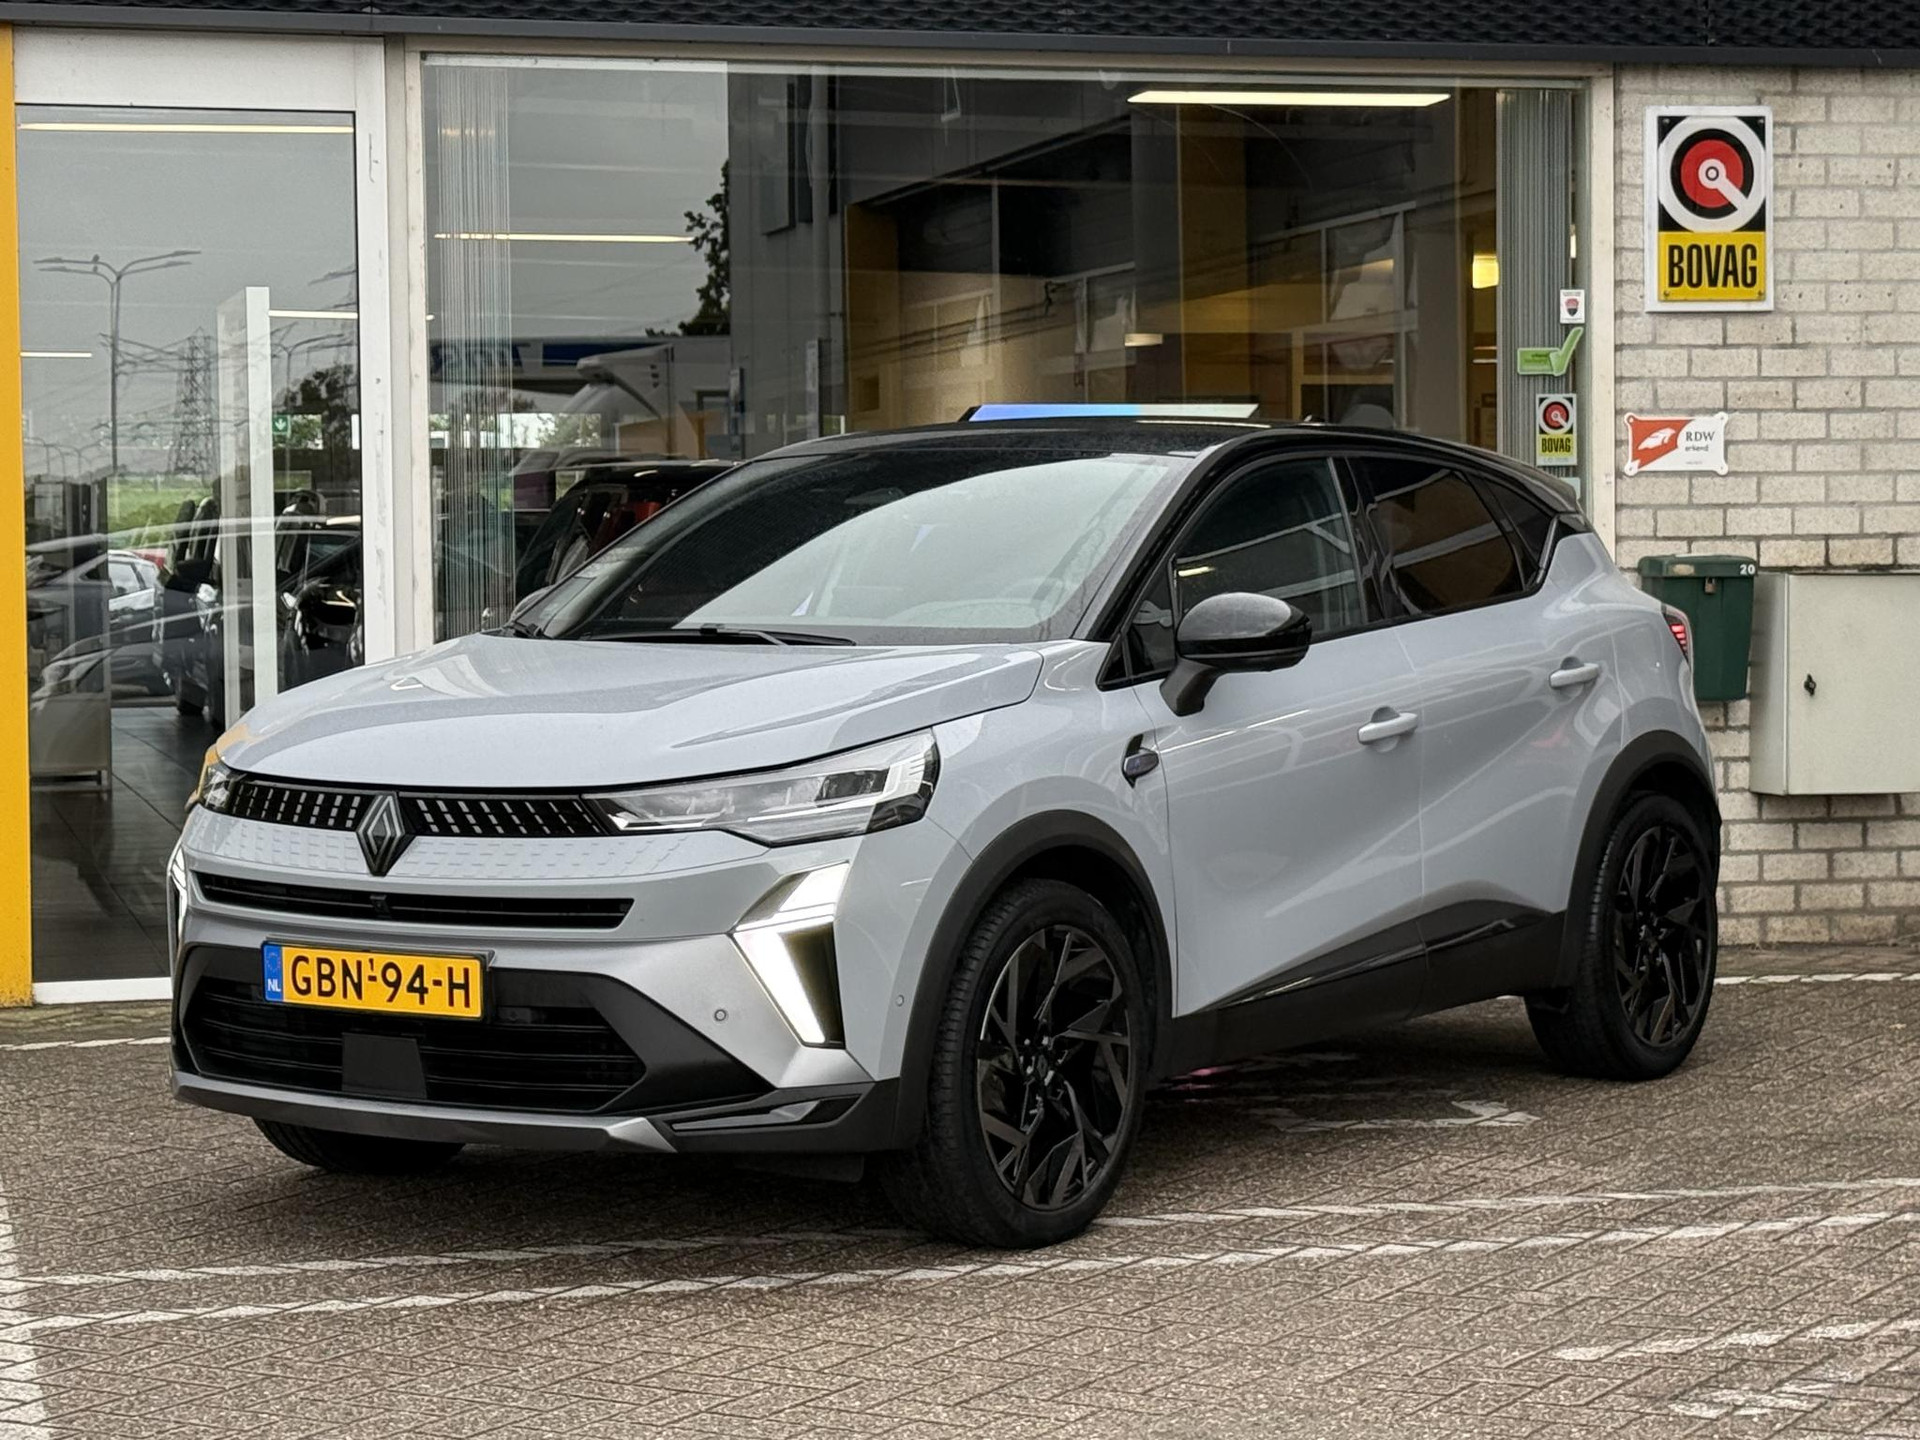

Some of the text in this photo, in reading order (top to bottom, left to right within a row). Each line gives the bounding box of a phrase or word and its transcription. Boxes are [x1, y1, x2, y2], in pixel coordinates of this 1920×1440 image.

[1668, 244, 1757, 288] BOVAG
[1685, 431, 1715, 442] RDW
[1541, 438, 1571, 453] BOVAG
[1739, 564, 1756, 575] 20
[268, 979, 281, 992] NL
